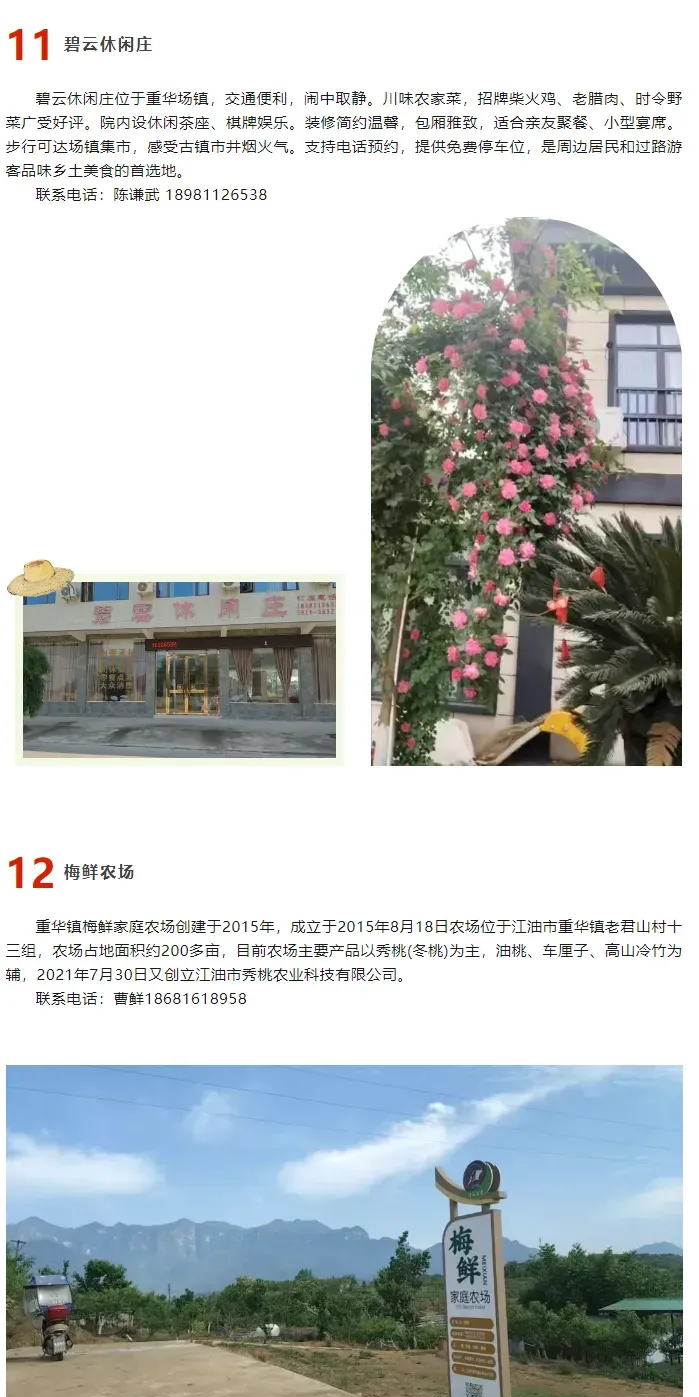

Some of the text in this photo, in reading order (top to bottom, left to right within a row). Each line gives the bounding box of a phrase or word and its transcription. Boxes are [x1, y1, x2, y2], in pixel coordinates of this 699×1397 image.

[9, 29, 152, 60] 11 碧云休闲庄
[36, 91, 682, 106] 碧云休闲庄位于重华场镇，交通便利，闹中取静。川味农家菜，招牌柴火鸡、老腊肉、时令野
[6, 115, 673, 130] 菜广受好评。院内设休闲茶座、棋牌娱乐。装修简约温馨，包厢雅致，适合亲友聚餐、小型宴席。
[6, 139, 682, 154] 步行可达场镇集市，感受古镇市井烟火气。支持电话预约，提供免费停车位，是周边居民和过路游
[6, 164, 182, 178] 客品味乡土美食的首选地。
[36, 188, 267, 201] 联系电话：陈谦武 18981126538
[9, 857, 133, 888] 12 梅鲜农场
[36, 919, 682, 934] 重华镇梅鲜家庭农场创建于2015年，成立于2015年8月18日农场位于江油市重华镇老君山村十
[6, 968, 403, 982] 辅，2021年7月30日又创立江油市秀桃农业科技有限公司。
[36, 992, 246, 1005] 联系电话：曹鲜18681618958
[448, 1225, 481, 1285] 梅鲜
[450, 1290, 491, 1304] 家庭农场
